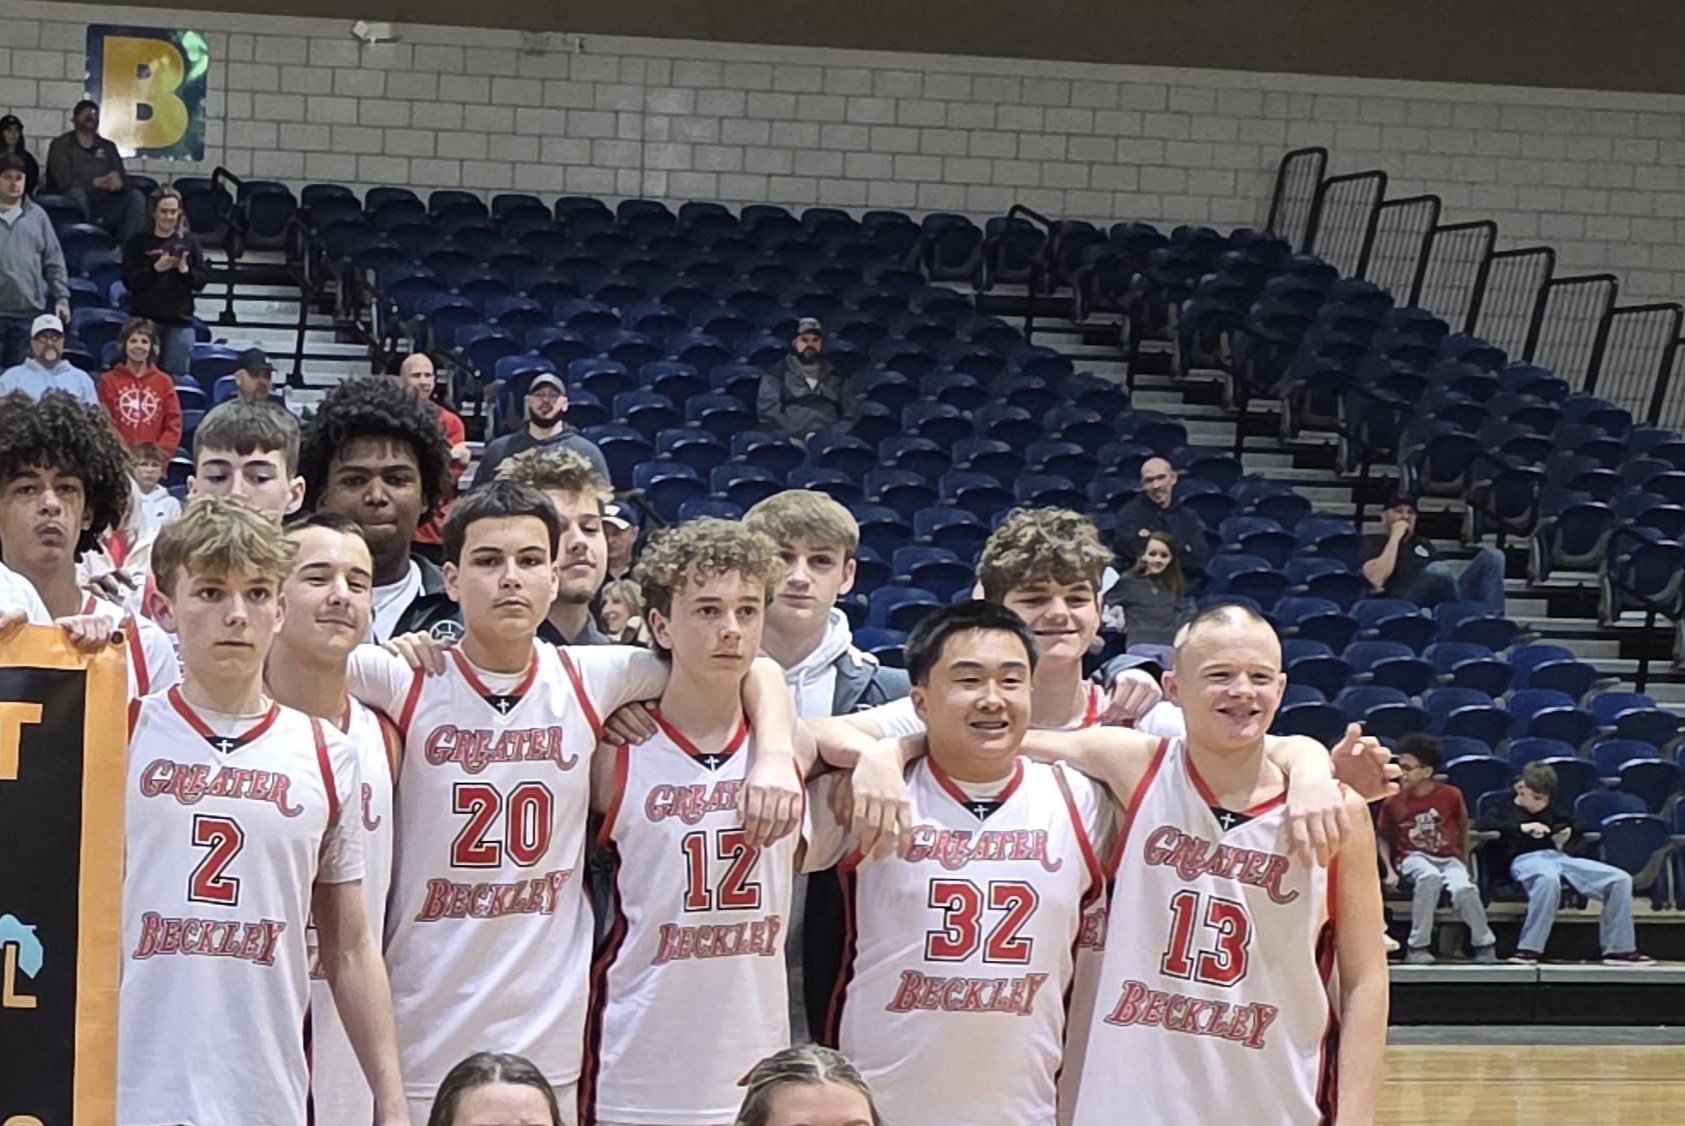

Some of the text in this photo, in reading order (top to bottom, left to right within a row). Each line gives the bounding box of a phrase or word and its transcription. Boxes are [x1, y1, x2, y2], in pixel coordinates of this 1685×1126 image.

[425, 724, 579, 775] GREATER
[140, 758, 304, 818] GREATER
[644, 779, 746, 826] GREAT
[450, 781, 554, 868] 20
[903, 824, 1063, 873] GREATER
[188, 813, 245, 907] 2
[681, 827, 762, 912] 12
[1144, 825, 1300, 905] GREATER
[414, 868, 574, 922] BECKLEY
[924, 877, 1040, 965] 32
[132, 911, 287, 967] BECKLEY
[1159, 888, 1253, 988] 13
[885, 969, 1049, 1016] BECKLEY
[1103, 979, 1279, 1049] BECKLEY
